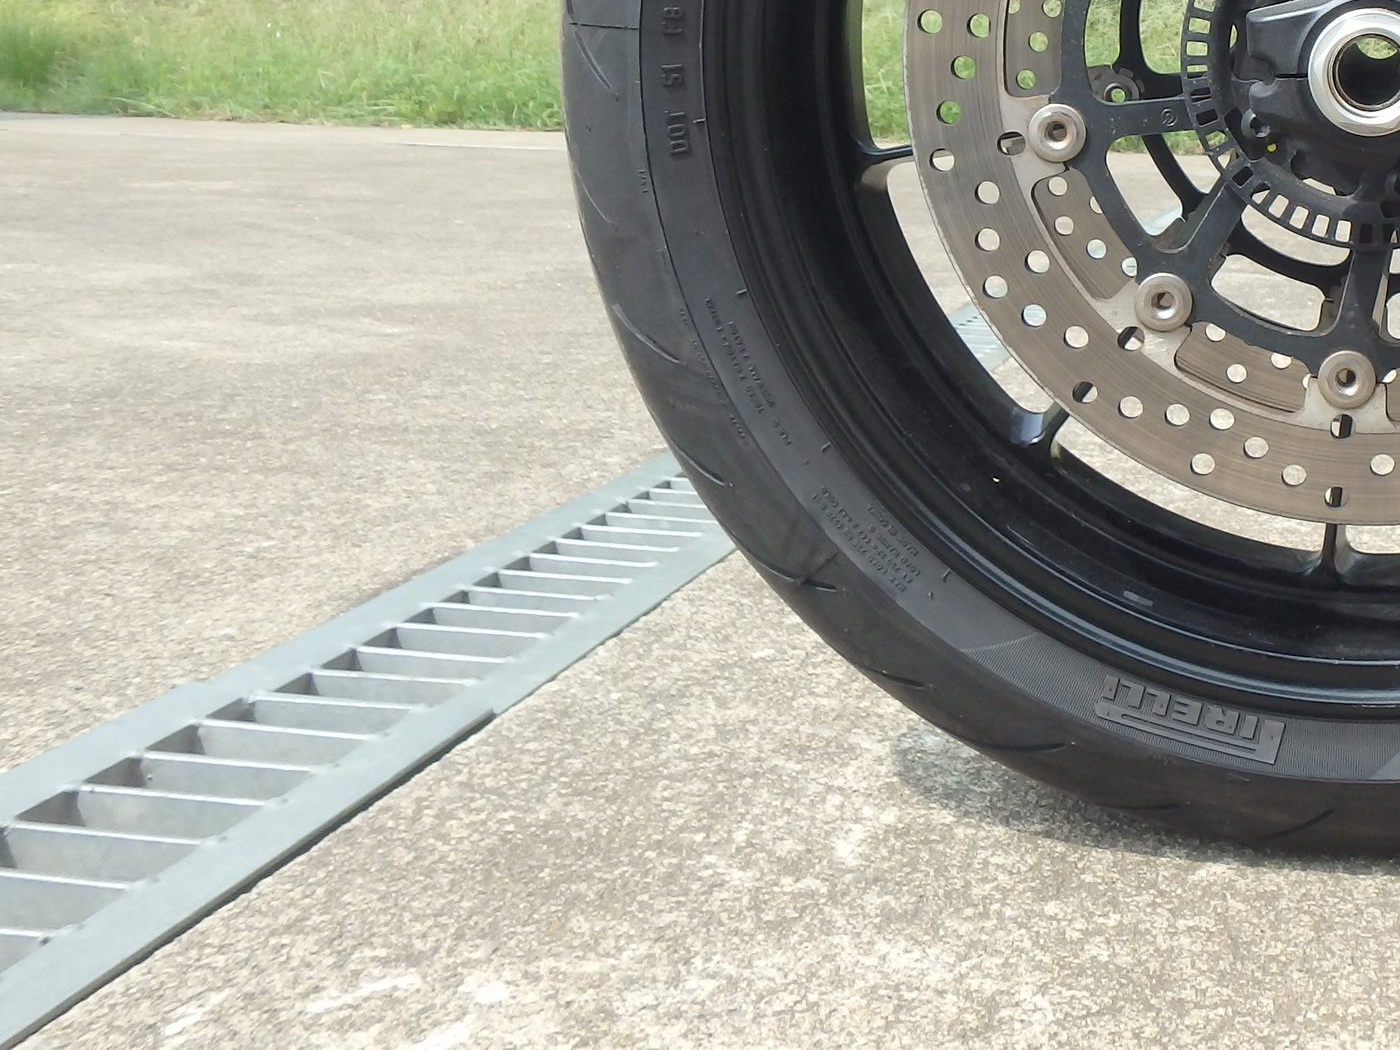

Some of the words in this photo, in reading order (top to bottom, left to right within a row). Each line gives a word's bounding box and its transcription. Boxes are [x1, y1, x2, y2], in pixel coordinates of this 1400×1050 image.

[660, 6, 684, 35] F8
[660, 63, 683, 88] 51
[664, 109, 690, 156] DOT
[1088, 670, 1286, 766] PIRELLI
